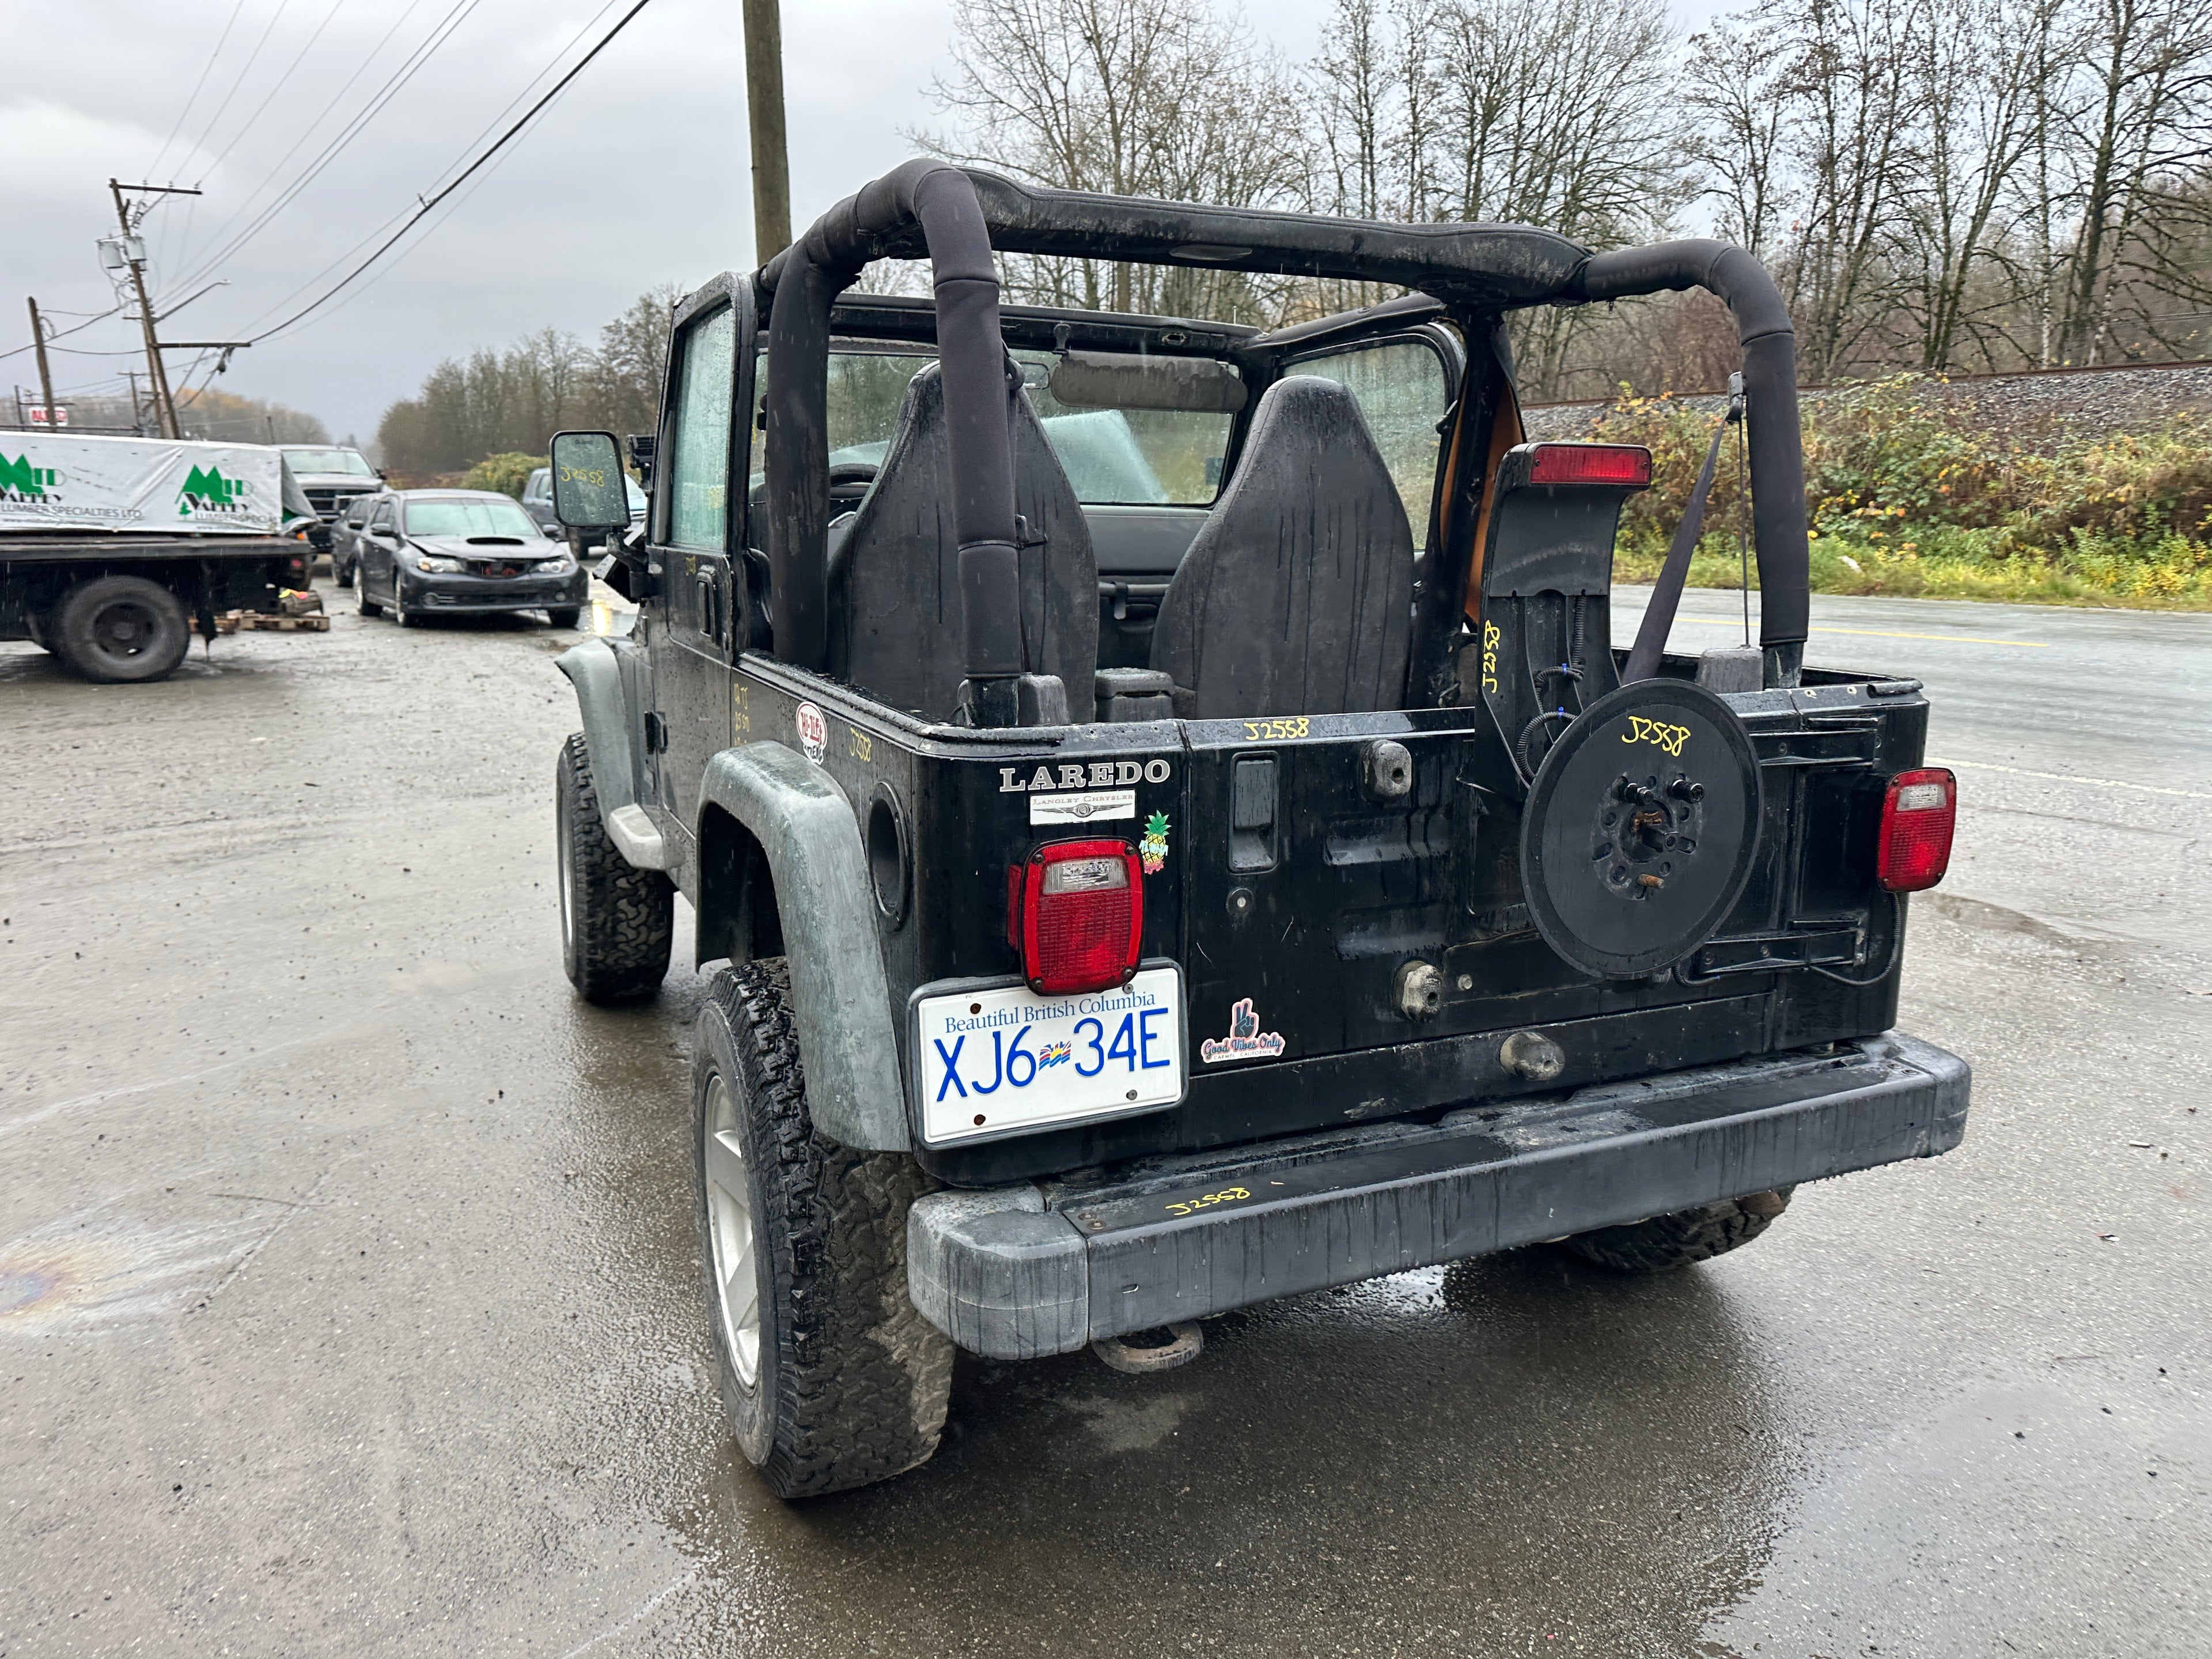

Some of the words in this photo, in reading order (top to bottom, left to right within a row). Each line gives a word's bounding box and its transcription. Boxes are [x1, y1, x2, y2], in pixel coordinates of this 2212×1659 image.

[560, 467, 605, 487] J2558
[51, 506, 118, 518] SPECIALTIES
[184, 493, 249, 513] VALLEY
[1482, 619, 1501, 694] J2558
[1243, 717, 1310, 741] J2558
[1622, 715, 1691, 757] J2558
[849, 727, 872, 762] J2558
[999, 759, 1171, 792] LAREDO
[1032, 797, 1080, 805] LANGLEY
[1083, 794, 1134, 803] CHRYSLER
[944, 1006, 1019, 1033] Beautiful
[1024, 1000, 1075, 1022] British
[1079, 991, 1156, 1015] Columbia
[1204, 1040, 1229, 1060] Good
[1231, 1039, 1257, 1051] Vibes
[1259, 1035, 1282, 1054] Only
[1165, 1187, 1251, 1216] J2558
